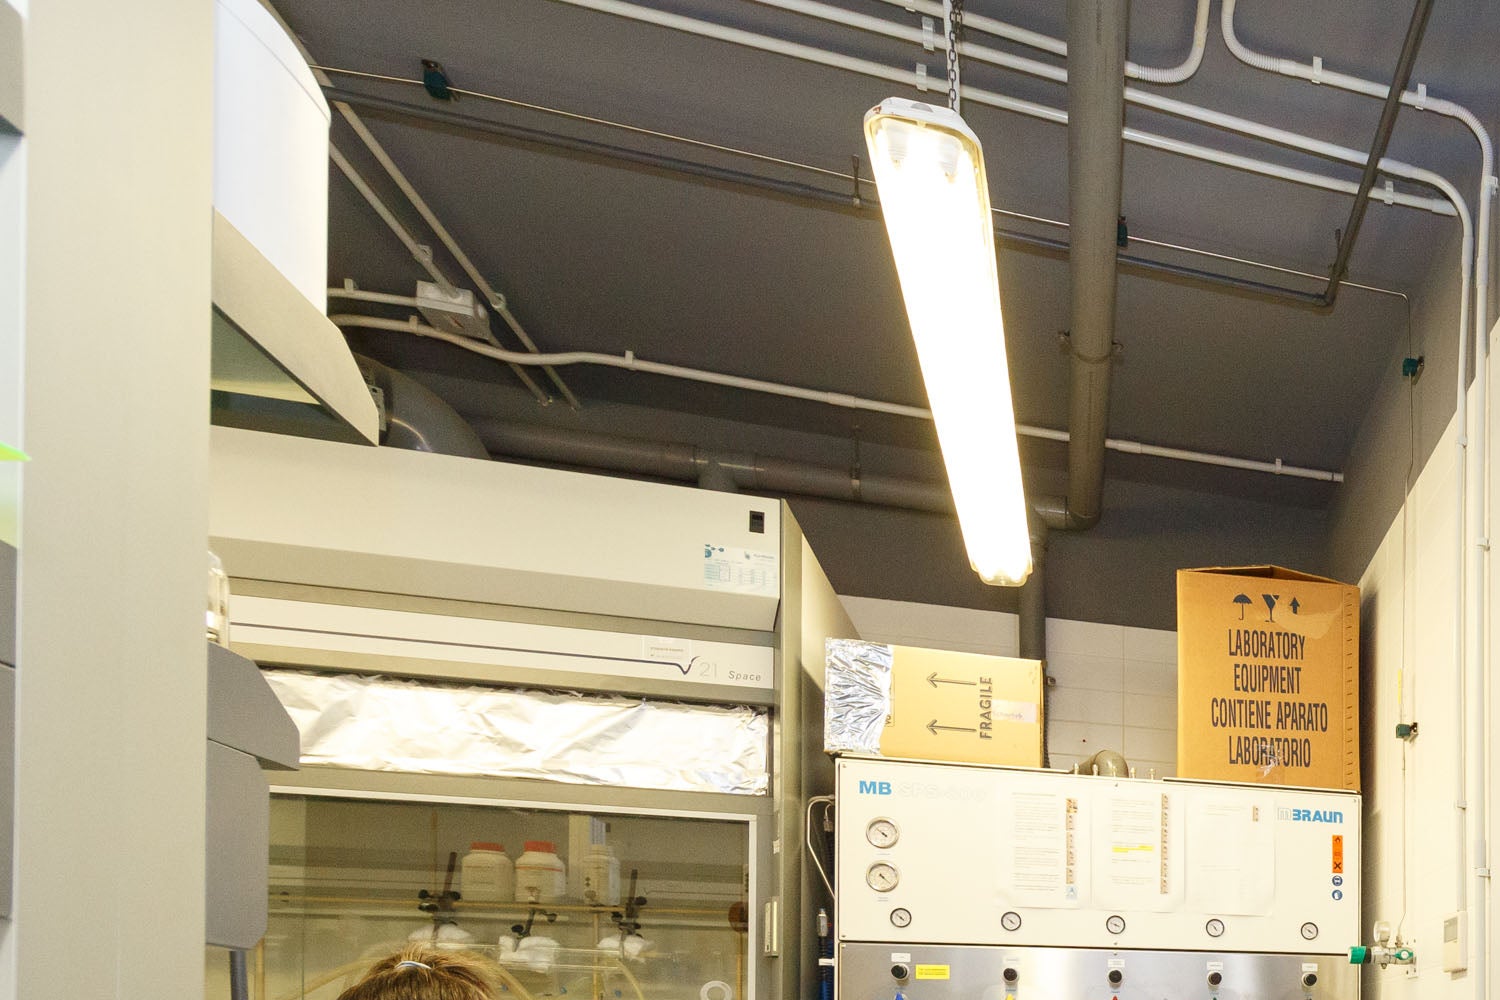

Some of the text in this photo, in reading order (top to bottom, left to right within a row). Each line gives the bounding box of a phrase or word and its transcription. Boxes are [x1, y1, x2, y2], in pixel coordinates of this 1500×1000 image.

[1228, 628, 1306, 661] LABORATORY
[728, 670, 762, 682] Space
[1233, 663, 1302, 695] EQUIPMENT
[979, 676, 993, 740] FRAGILE
[1211, 697, 1328, 732] CONTIENE APARATO
[1228, 735, 1311, 768] LABORATORIO
[859, 780, 892, 796] MB
